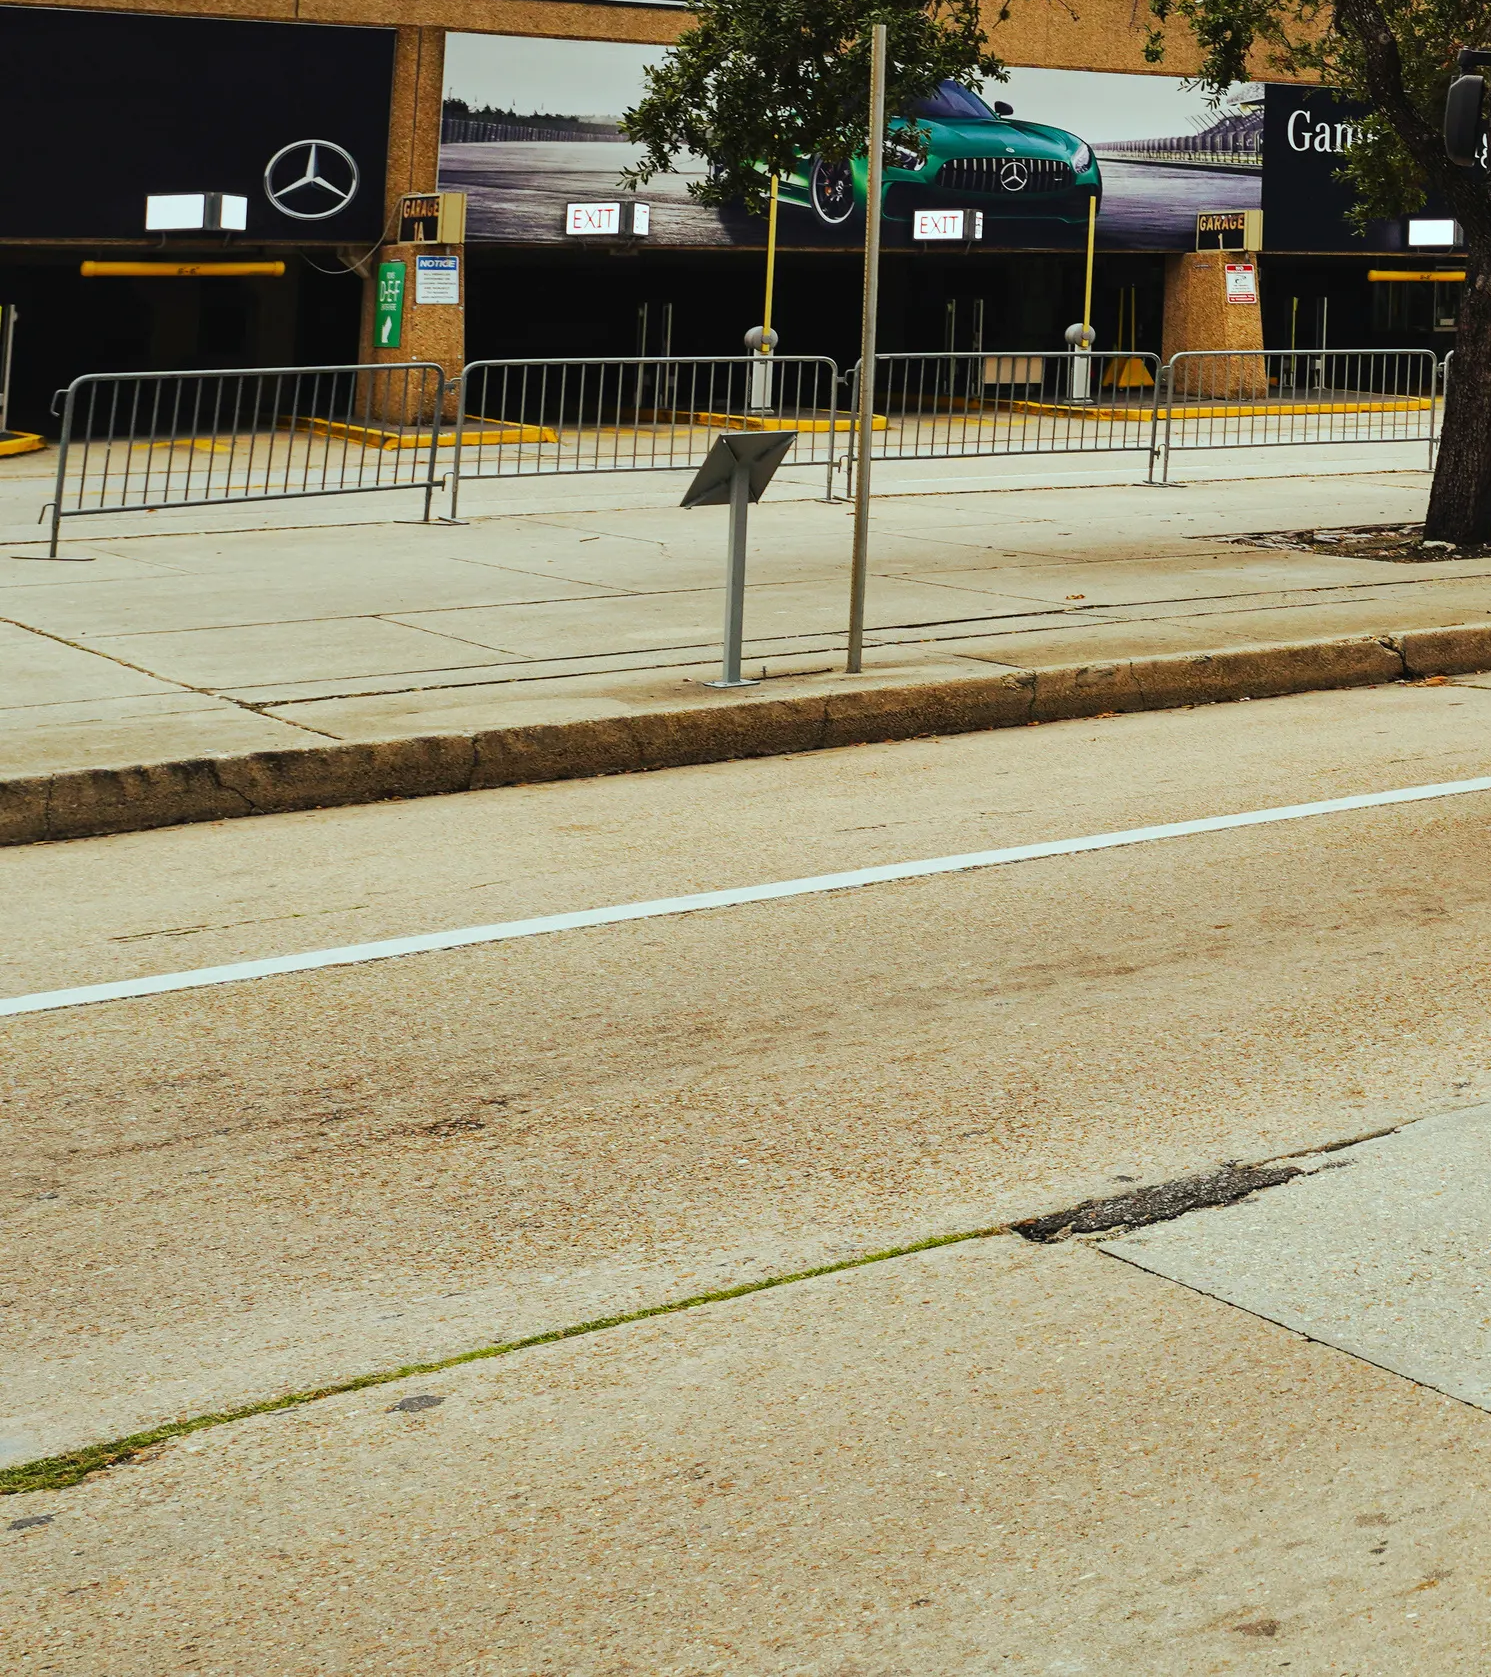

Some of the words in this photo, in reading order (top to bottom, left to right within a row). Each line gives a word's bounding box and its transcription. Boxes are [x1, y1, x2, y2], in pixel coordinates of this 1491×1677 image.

[403, 199, 440, 218] GARAGE
[573, 208, 615, 229] EXIT
[920, 216, 959, 234] EXIT
[1200, 214, 1245, 231] GARAGE
[413, 221, 425, 242] 1A
[1218, 232, 1224, 251] 1
[420, 260, 456, 268] NOTICE
